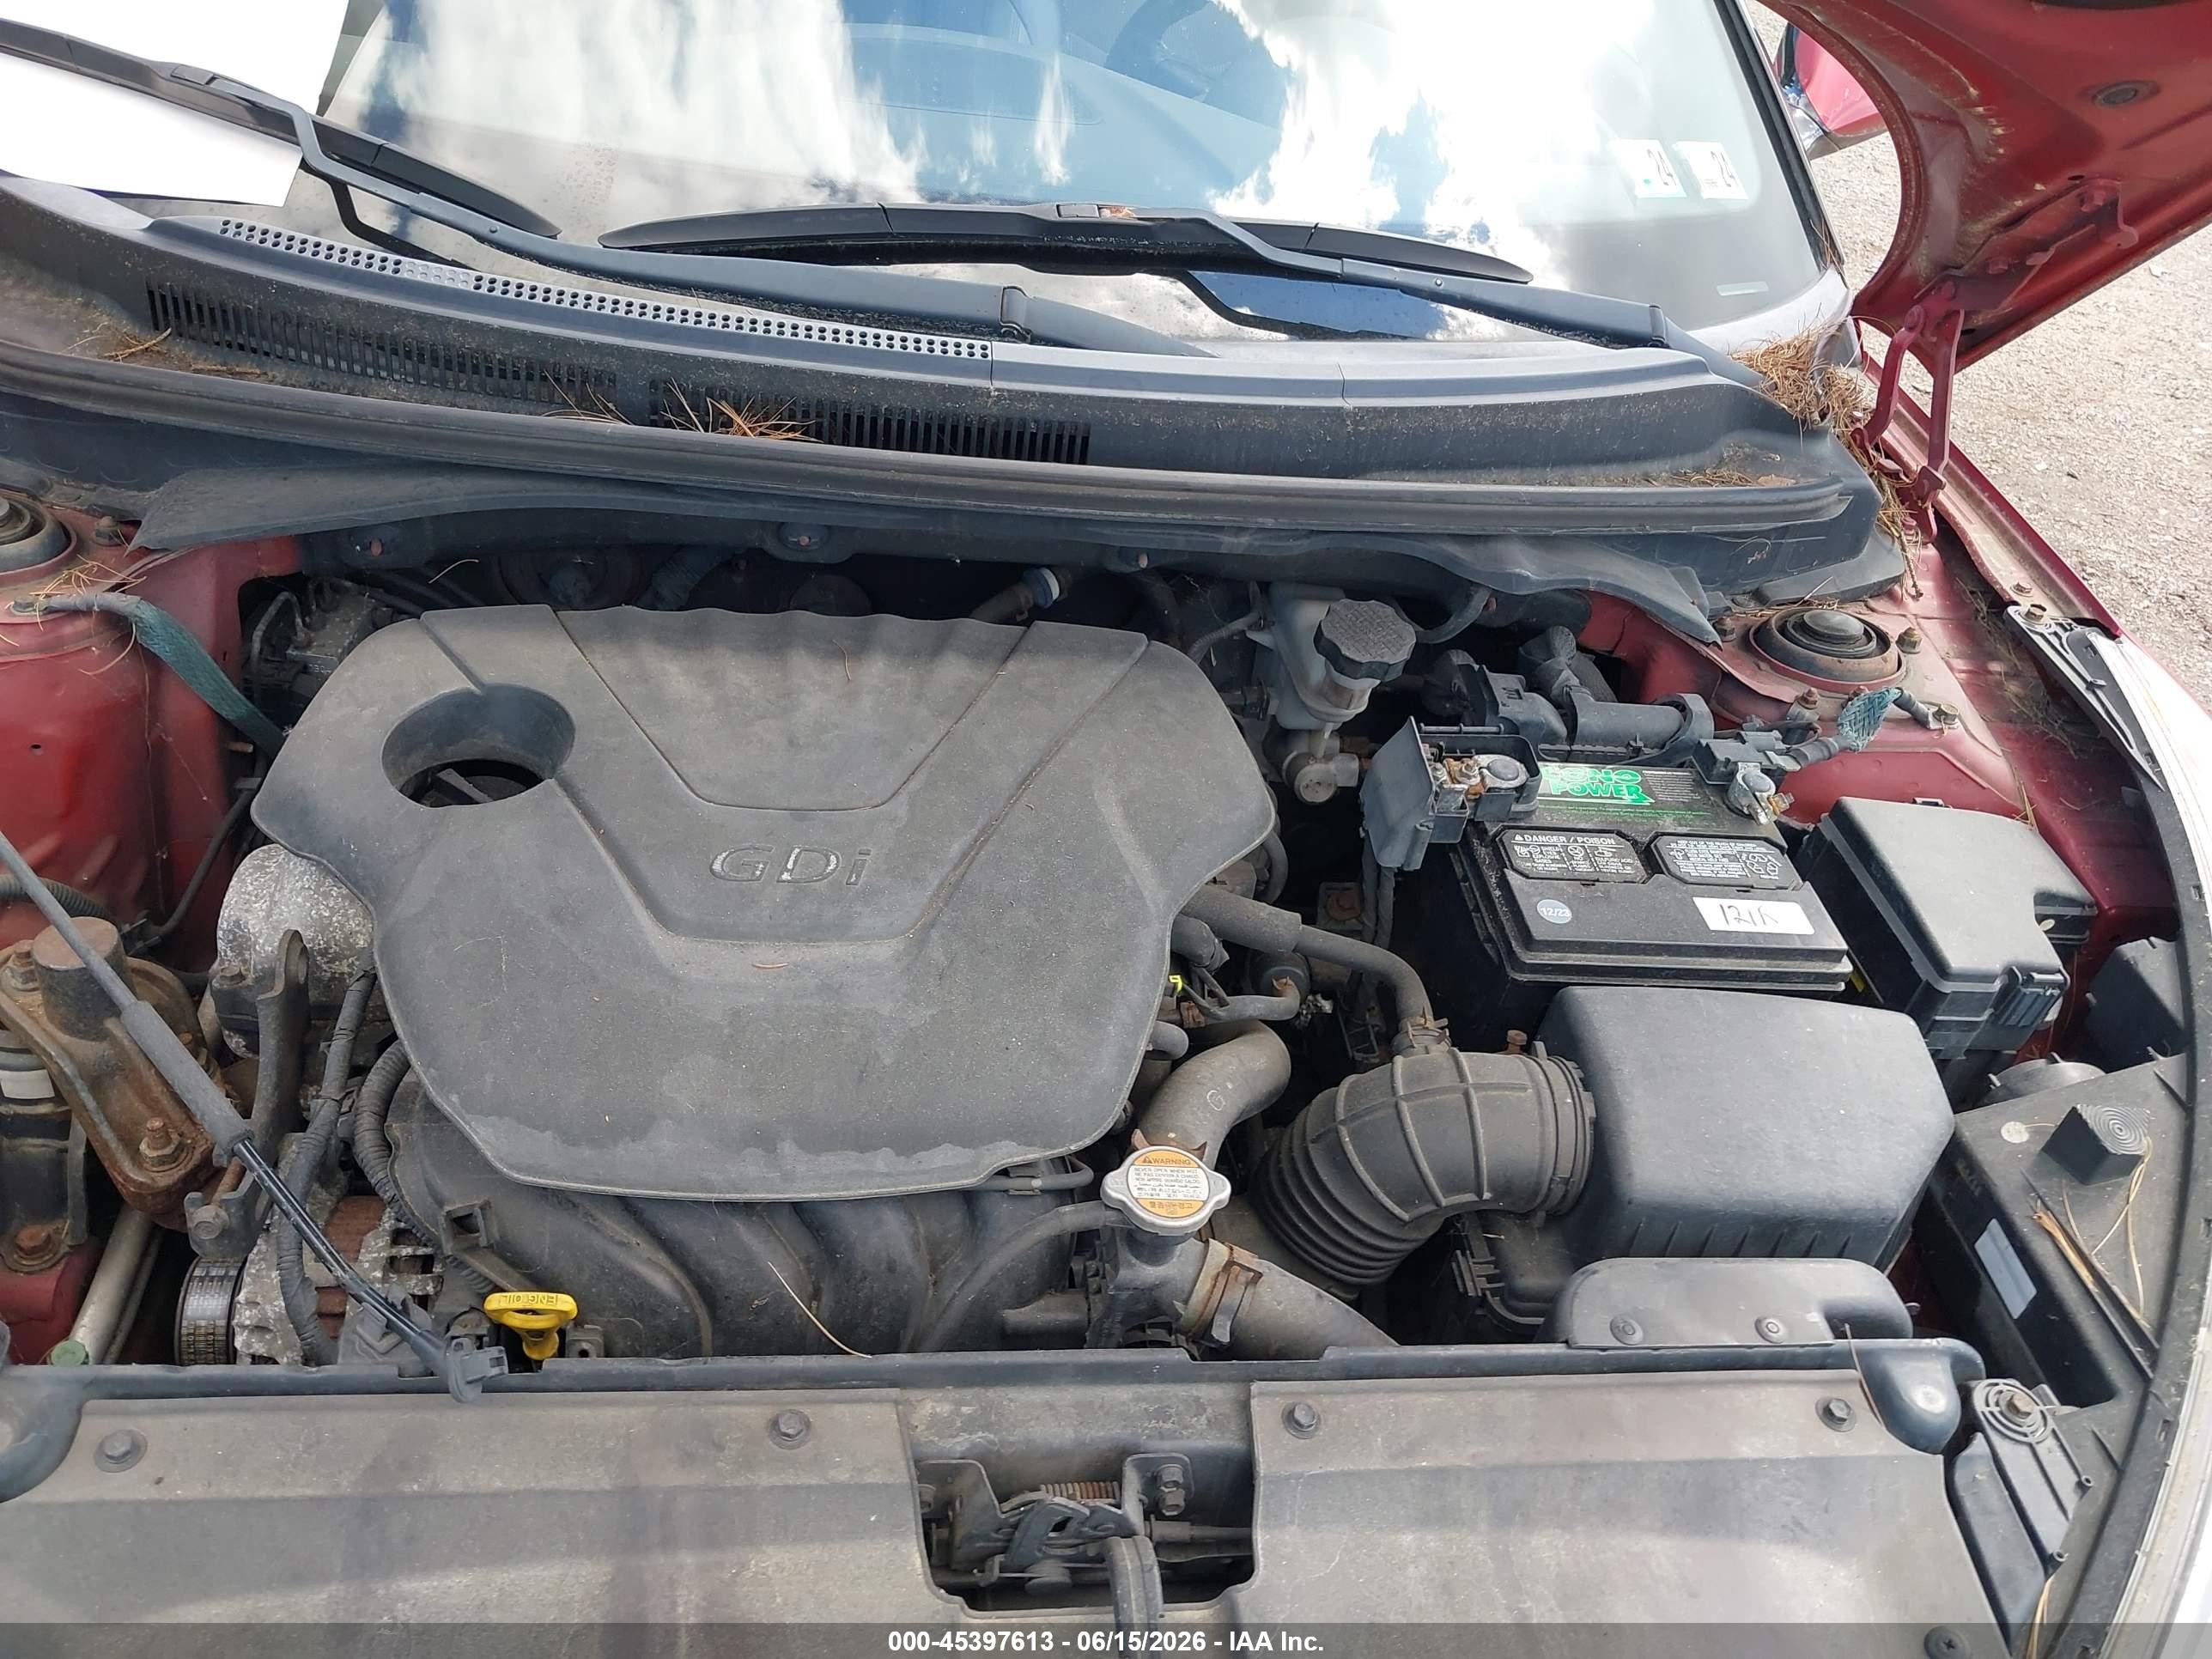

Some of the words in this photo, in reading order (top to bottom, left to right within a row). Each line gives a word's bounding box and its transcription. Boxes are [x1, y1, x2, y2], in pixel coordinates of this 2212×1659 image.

[1550, 782, 1646, 800] POWER
[1523, 834, 1567, 843] DANGER
[1576, 836, 1616, 845] POISON
[709, 842, 872, 886] GDi
[501, 1294, 522, 1305] OIL
[528, 1294, 556, 1305] ENG
